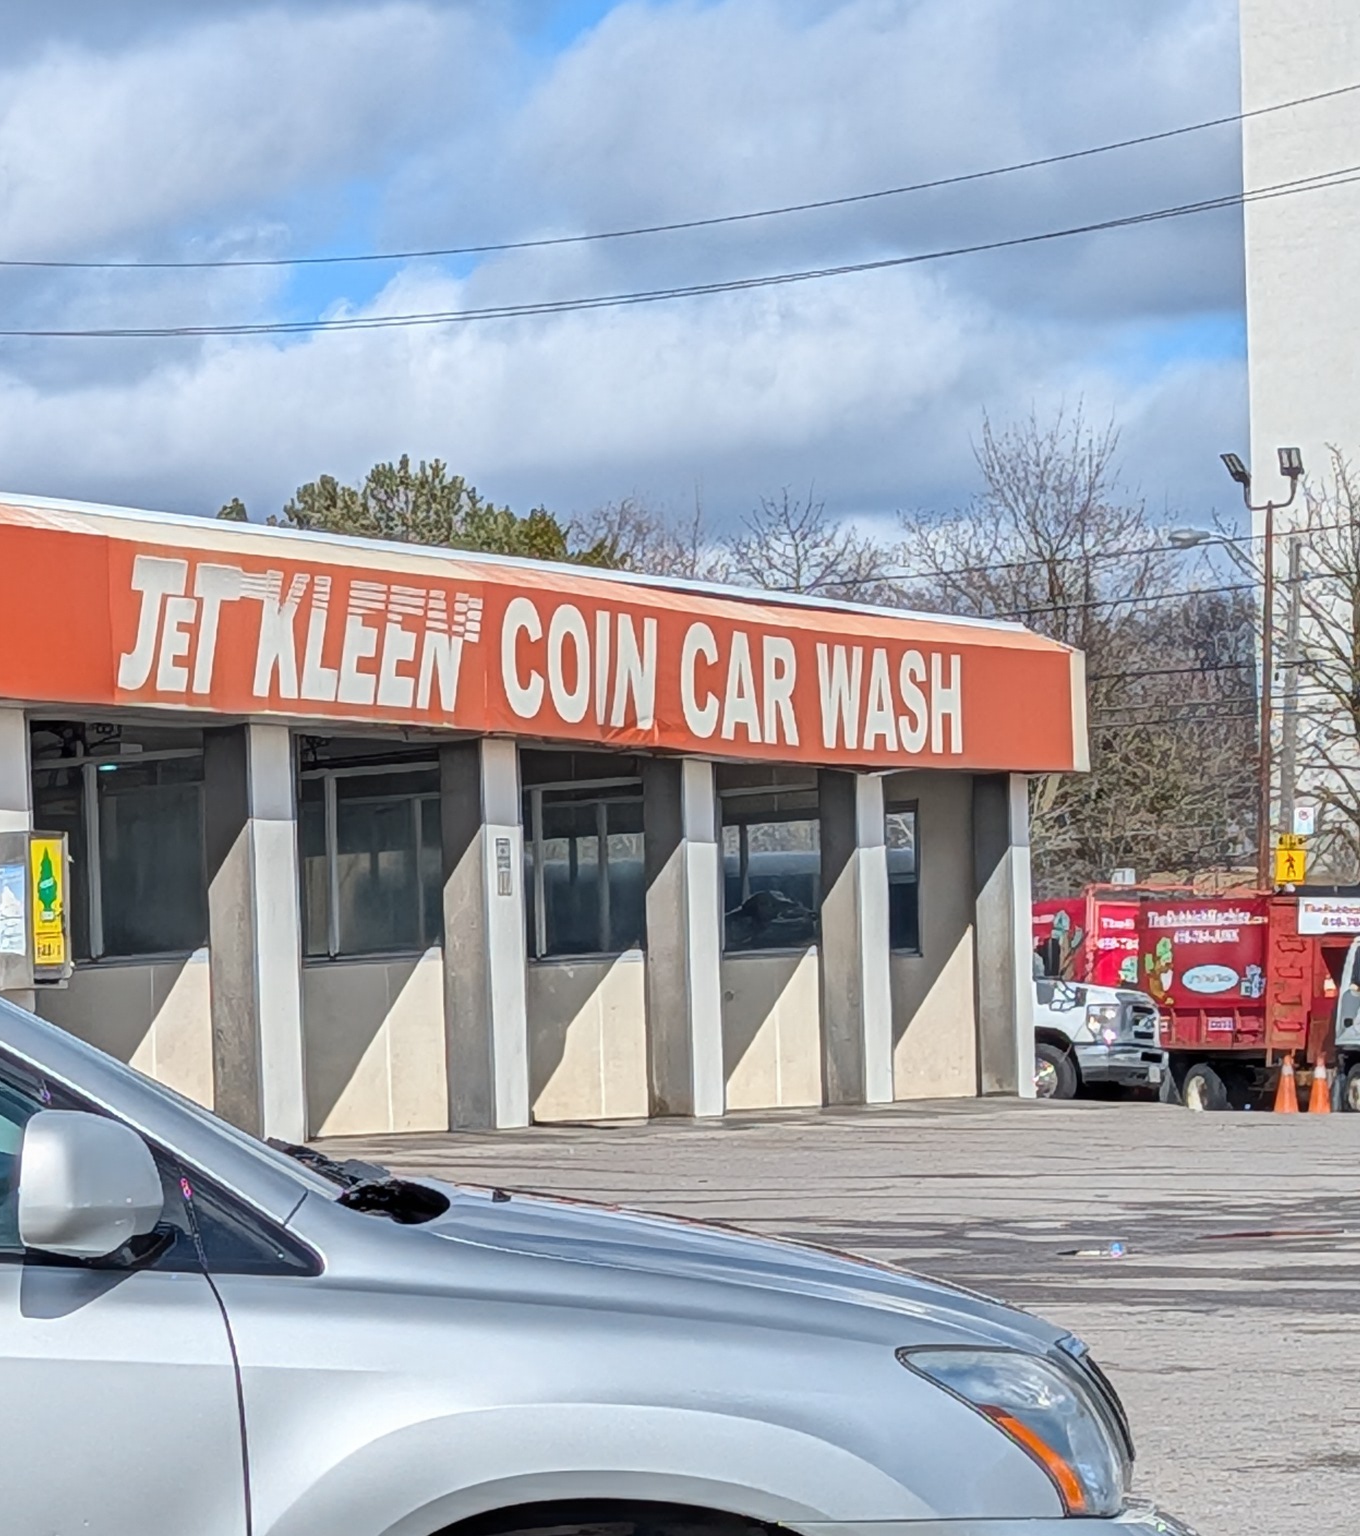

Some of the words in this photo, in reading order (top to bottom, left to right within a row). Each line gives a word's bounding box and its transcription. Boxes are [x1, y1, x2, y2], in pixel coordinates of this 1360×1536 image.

[117, 554, 242, 694] JET
[252, 569, 483, 712] KLEEN
[501, 597, 658, 730] COIN
[681, 622, 800, 747] CAR
[816, 642, 963, 754] WASH
